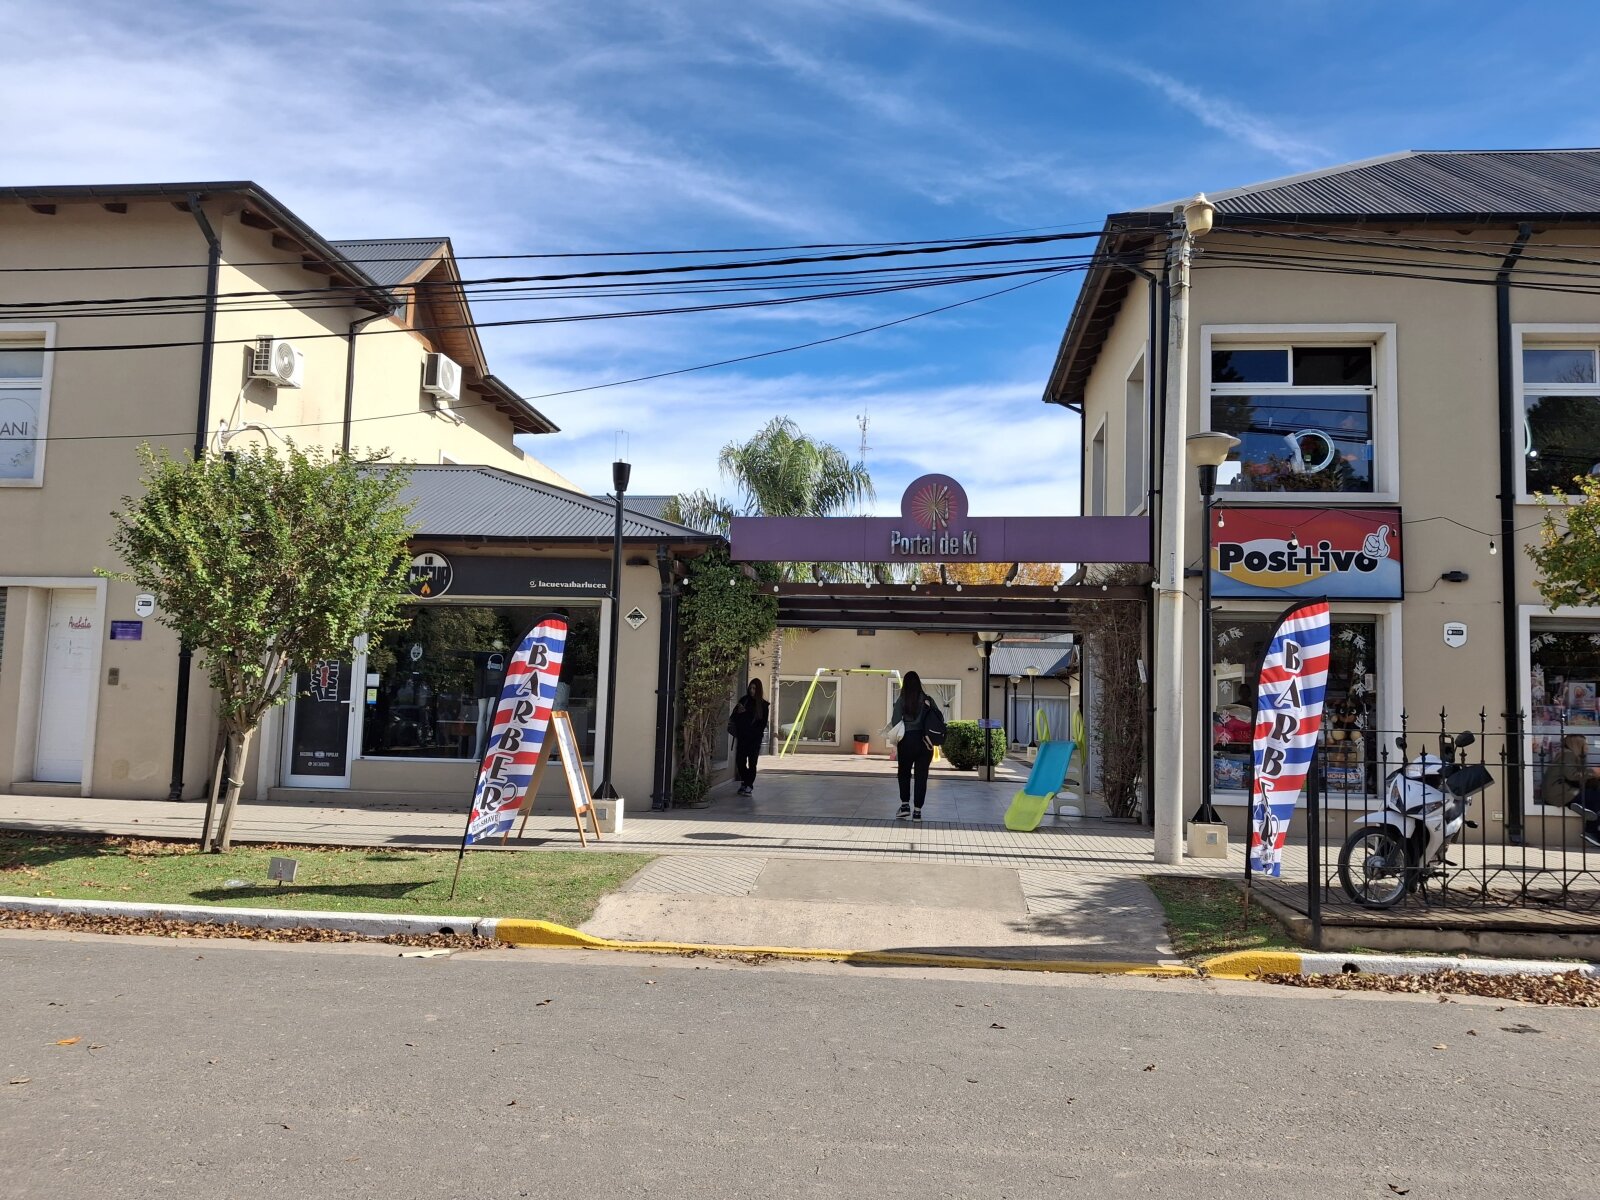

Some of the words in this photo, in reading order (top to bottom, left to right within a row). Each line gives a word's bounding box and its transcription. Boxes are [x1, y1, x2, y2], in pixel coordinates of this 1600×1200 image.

[891, 529, 936, 555] Portal
[939, 530, 960, 555] de
[962, 530, 977, 555] Ki
[480, 642, 549, 812] BARBER
